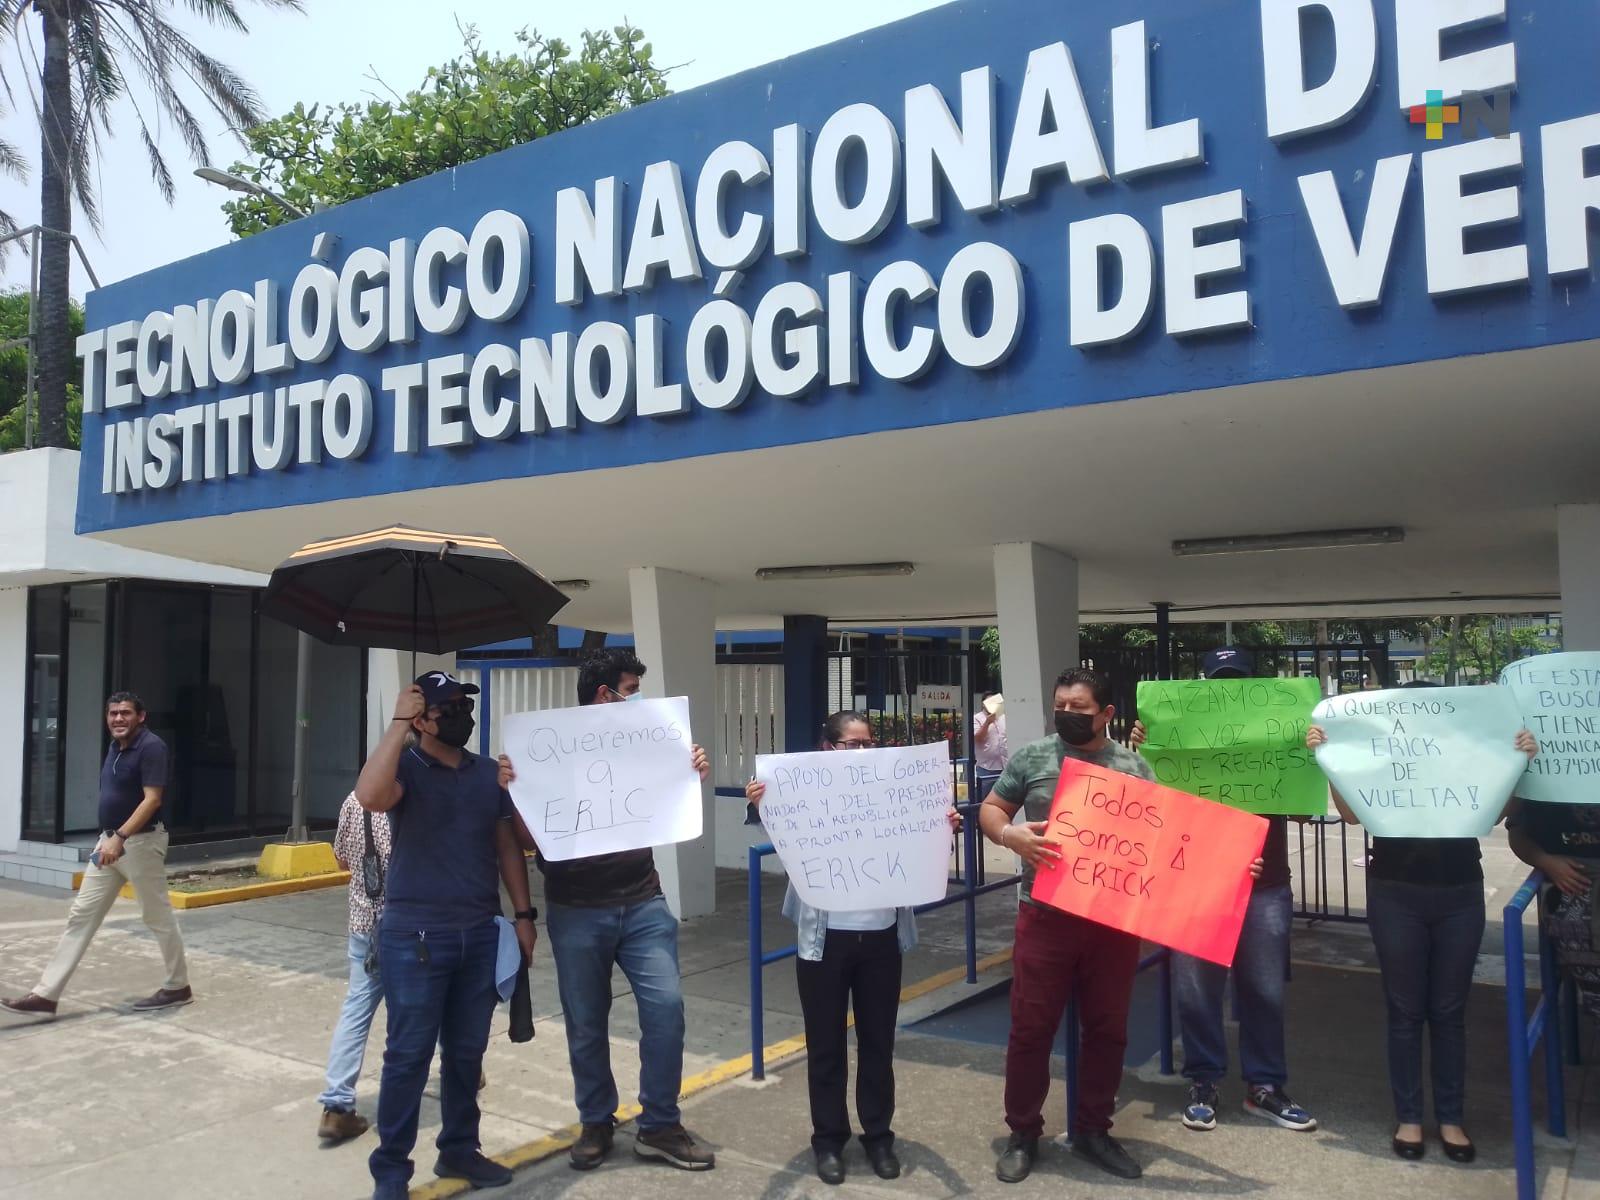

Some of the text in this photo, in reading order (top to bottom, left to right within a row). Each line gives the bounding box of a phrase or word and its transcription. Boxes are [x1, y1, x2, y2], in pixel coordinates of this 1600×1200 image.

[76, 209, 530, 414] TECNOLÓGICO
[556, 19, 1204, 305] NACIONAL
[102, 373, 373, 495] INSTITUTO
[382, 241, 1025, 453] TECNOLÓGICO
[1069, 189, 1255, 350] DE
[921, 691, 951, 701] SALIDA
[1539, 690, 1600, 708] BUSC
[1198, 723, 1248, 750] VOZ
[1393, 718, 1406, 735] A
[527, 721, 683, 764] Queremos
[1371, 737, 1442, 758] ERICK
[774, 766, 833, 797] APOYO
[844, 763, 886, 787] DEL
[1154, 756, 1206, 784] QUE
[1392, 762, 1418, 782] DE
[839, 793, 880, 812] DEL
[1076, 773, 1164, 829] Todos
[808, 816, 825, 830] LA
[796, 828, 864, 851] PRONTA
[1055, 811, 1148, 867] Somos
[801, 851, 908, 894] ERICK
[1072, 857, 1156, 898] ERICK
